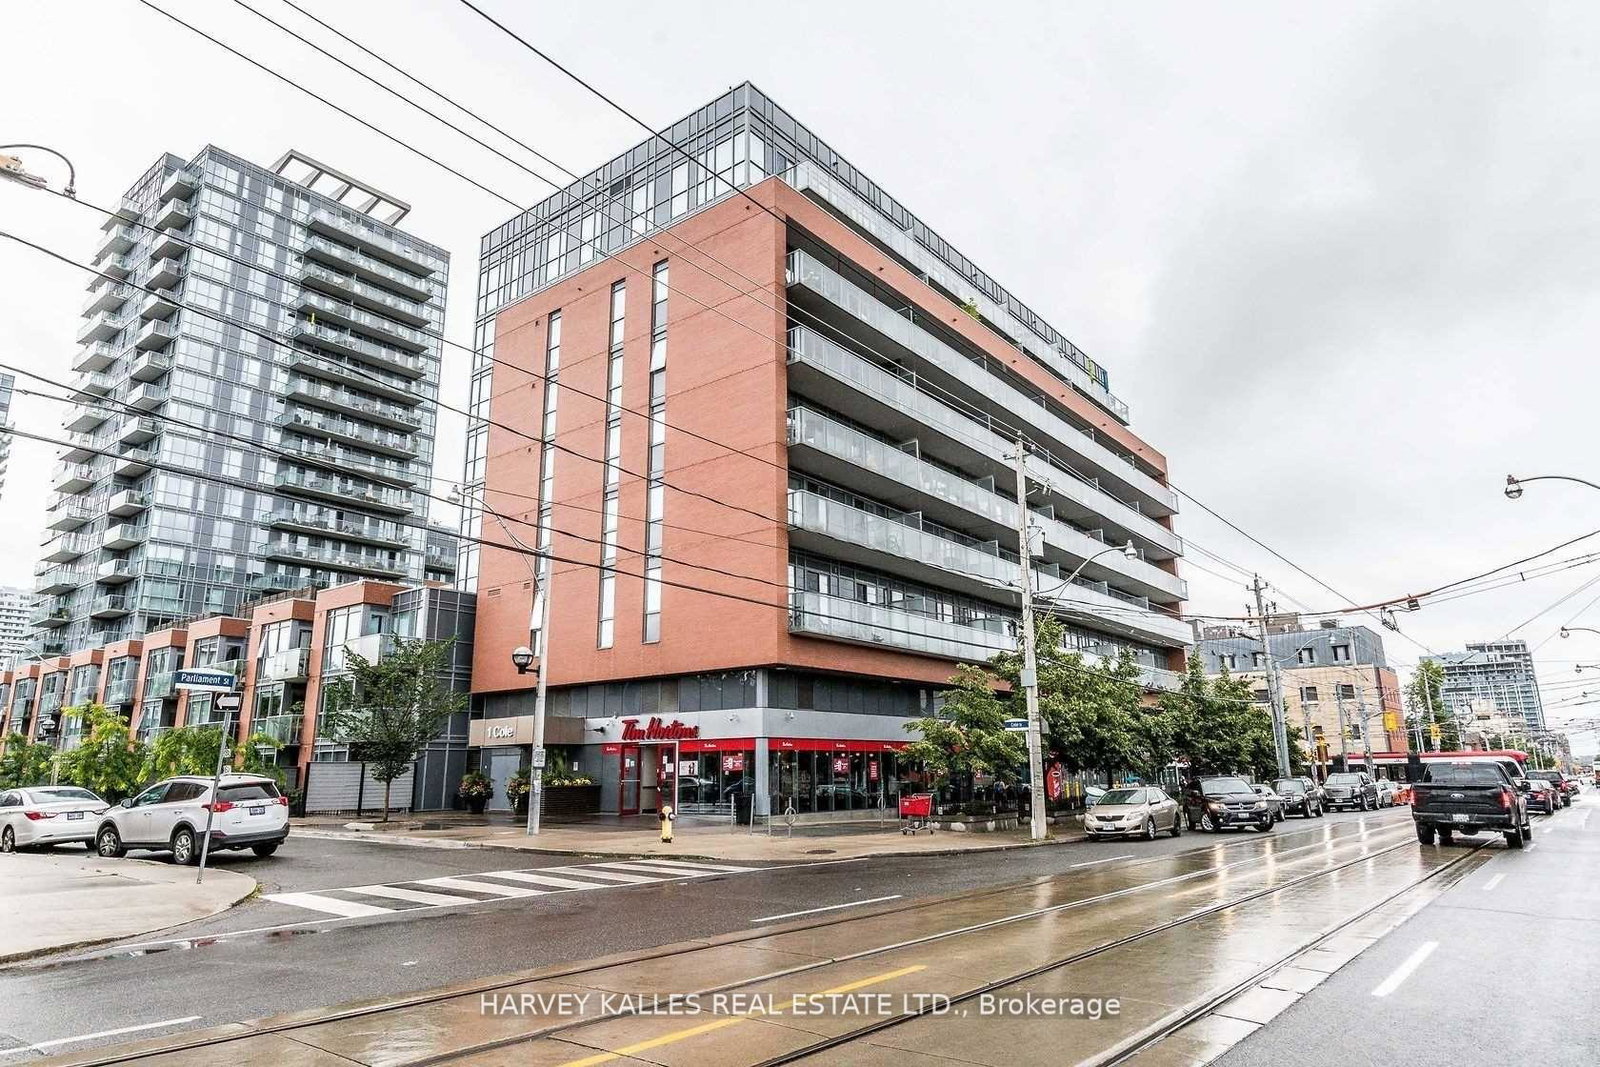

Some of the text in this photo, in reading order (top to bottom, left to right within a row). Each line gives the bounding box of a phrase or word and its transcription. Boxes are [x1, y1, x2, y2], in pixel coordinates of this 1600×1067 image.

[181, 673, 230, 685] Parliament St
[488, 725, 514, 738] 1 Cole
[622, 716, 700, 740] Tim Hortons
